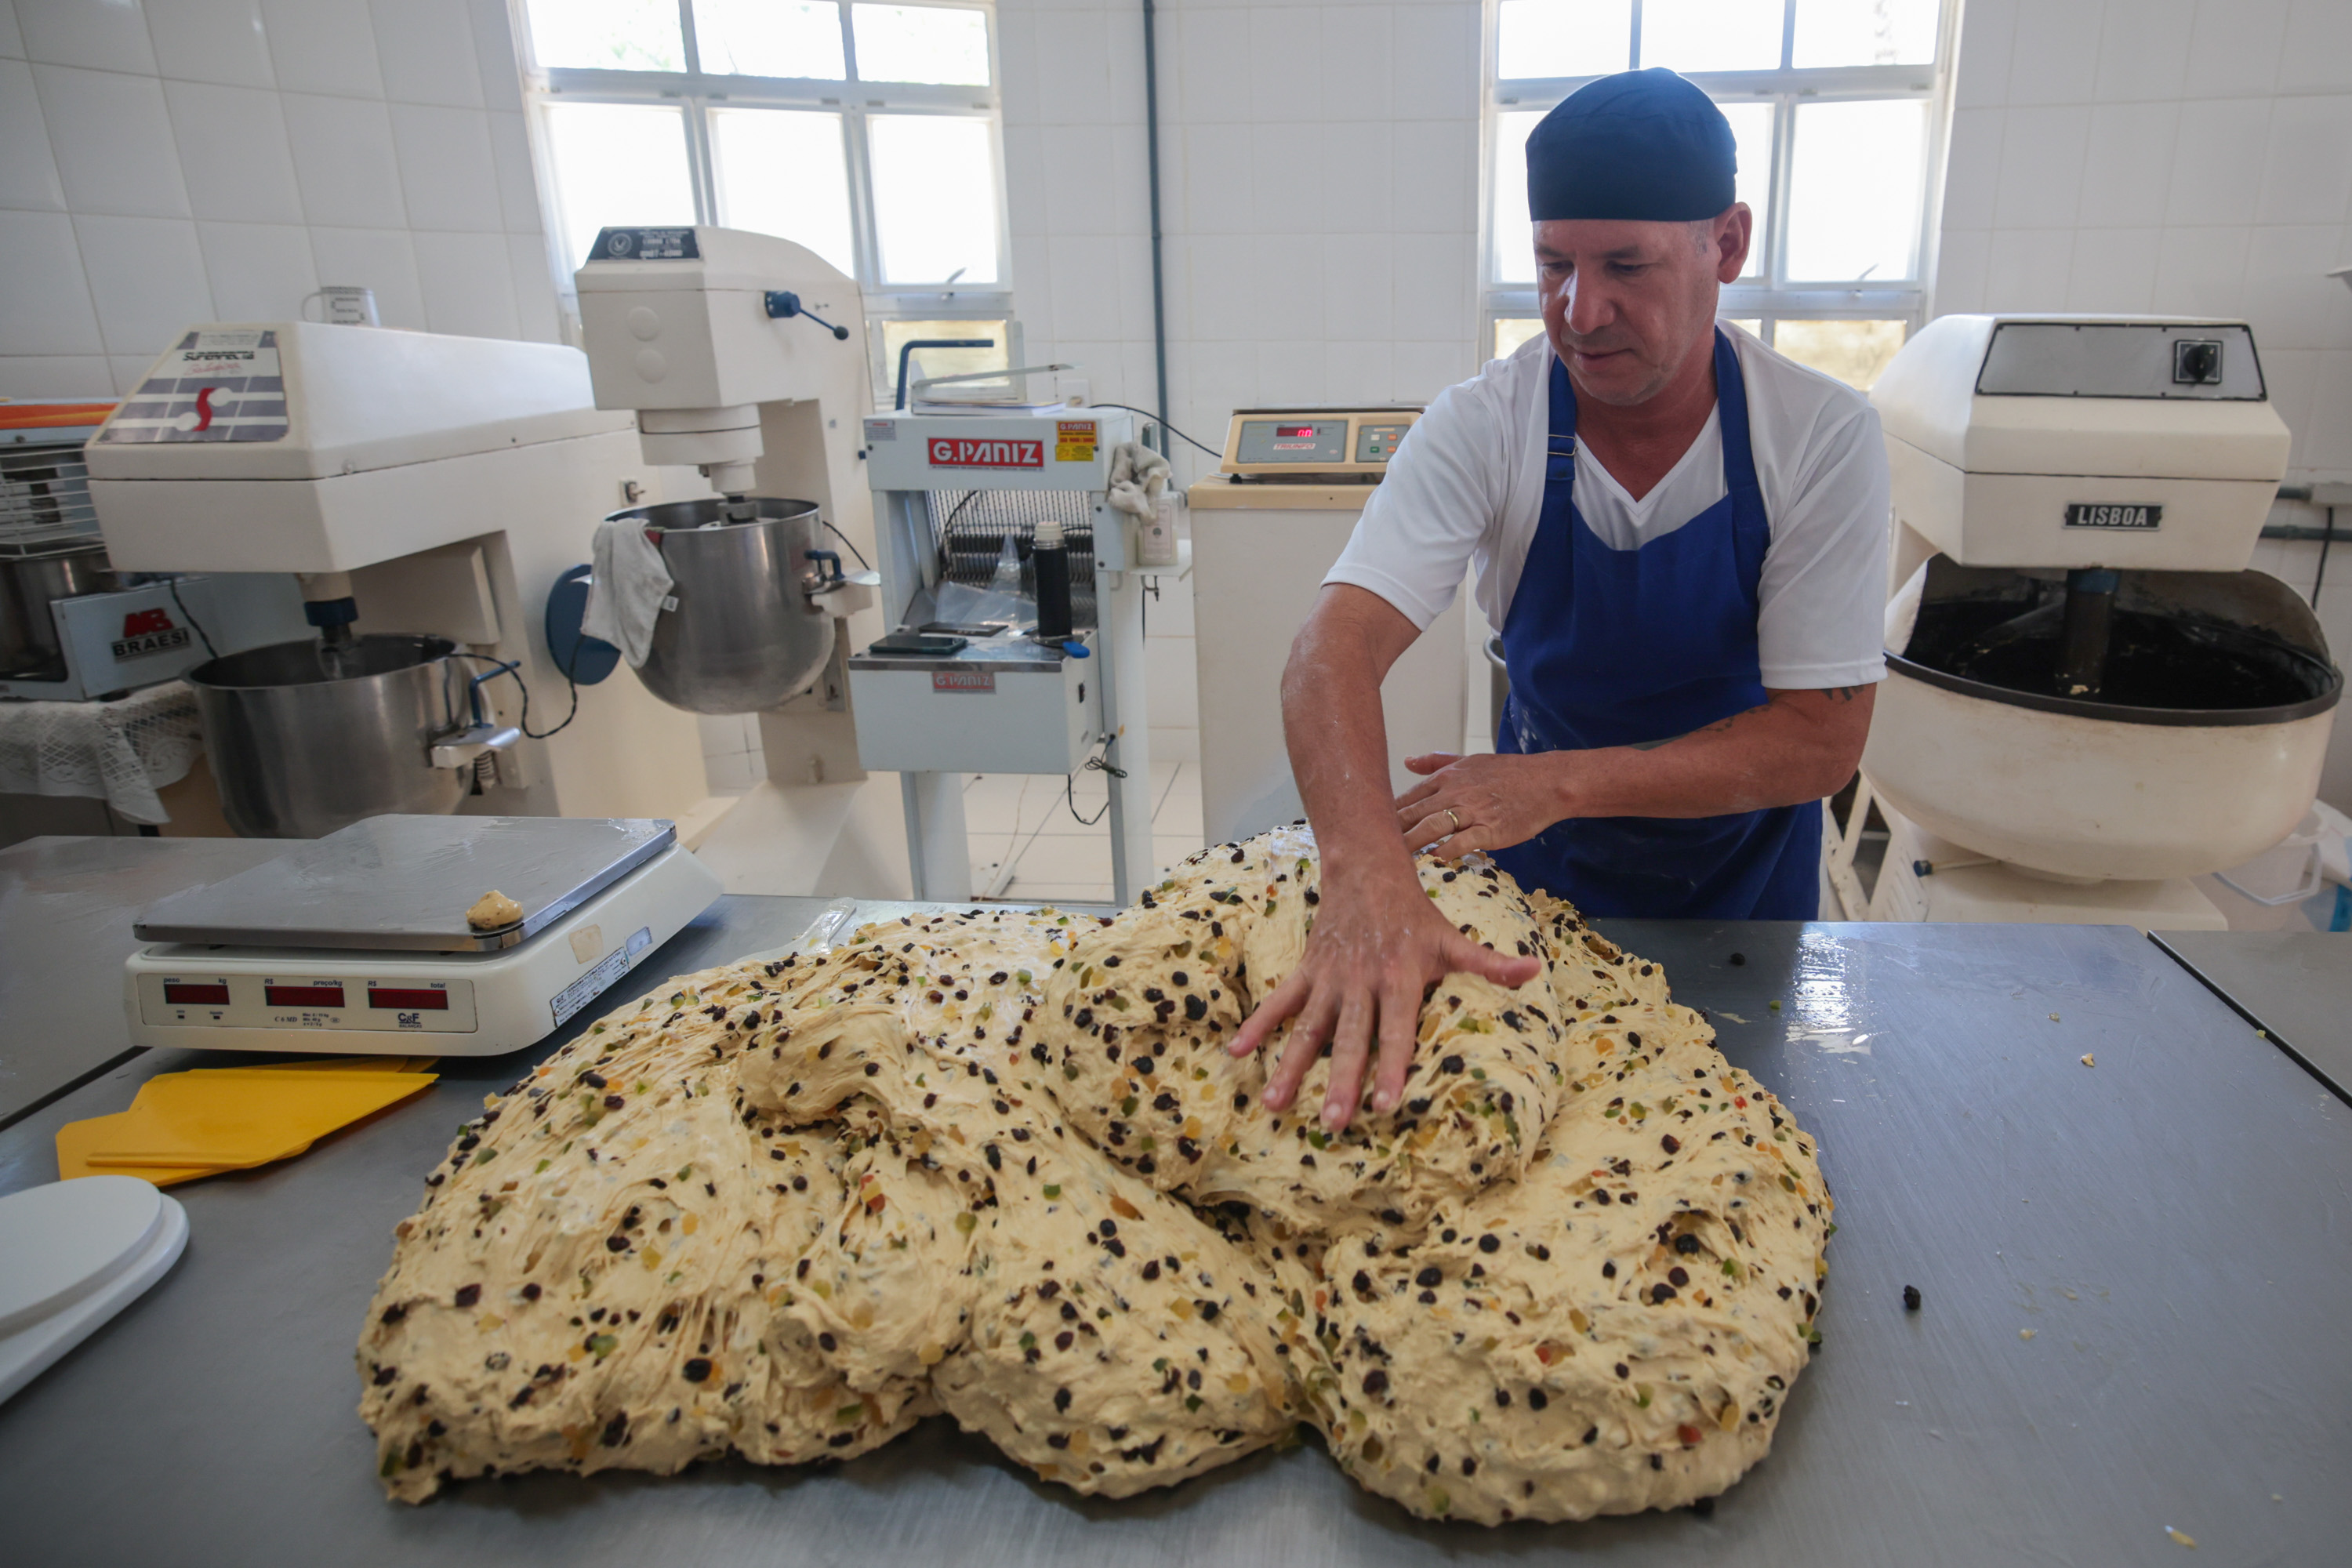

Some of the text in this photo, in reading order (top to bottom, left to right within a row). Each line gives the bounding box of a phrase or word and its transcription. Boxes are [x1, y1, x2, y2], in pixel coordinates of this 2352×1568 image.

[933, 441, 1039, 463] G.PANIZ
[2077, 506, 2147, 525] LISBOA
[112, 630, 189, 656] BRAESI
[397, 1012, 420, 1024] C&F
